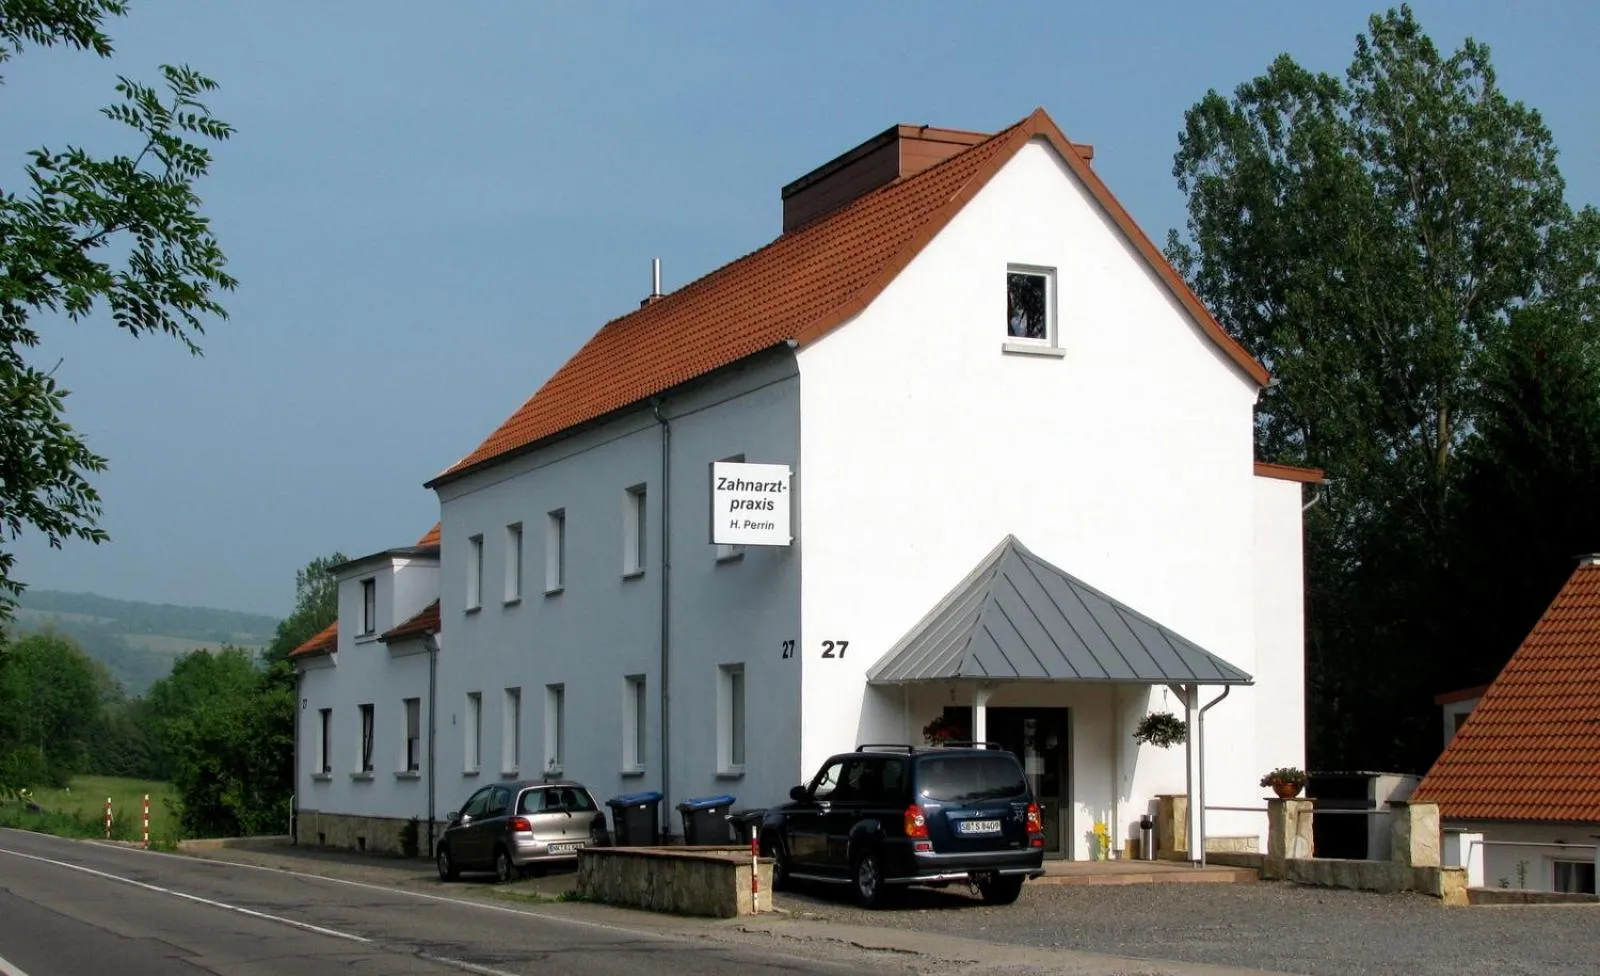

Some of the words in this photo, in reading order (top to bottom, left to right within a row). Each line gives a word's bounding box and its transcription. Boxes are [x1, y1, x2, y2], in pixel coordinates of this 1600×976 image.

[717, 477, 787, 493] Zahnarzt-
[729, 497, 775, 512] praxis
[730, 519, 741, 529] H.
[744, 519, 775, 531] Perrin
[782, 640, 795, 659] 27
[821, 640, 849, 659] 27
